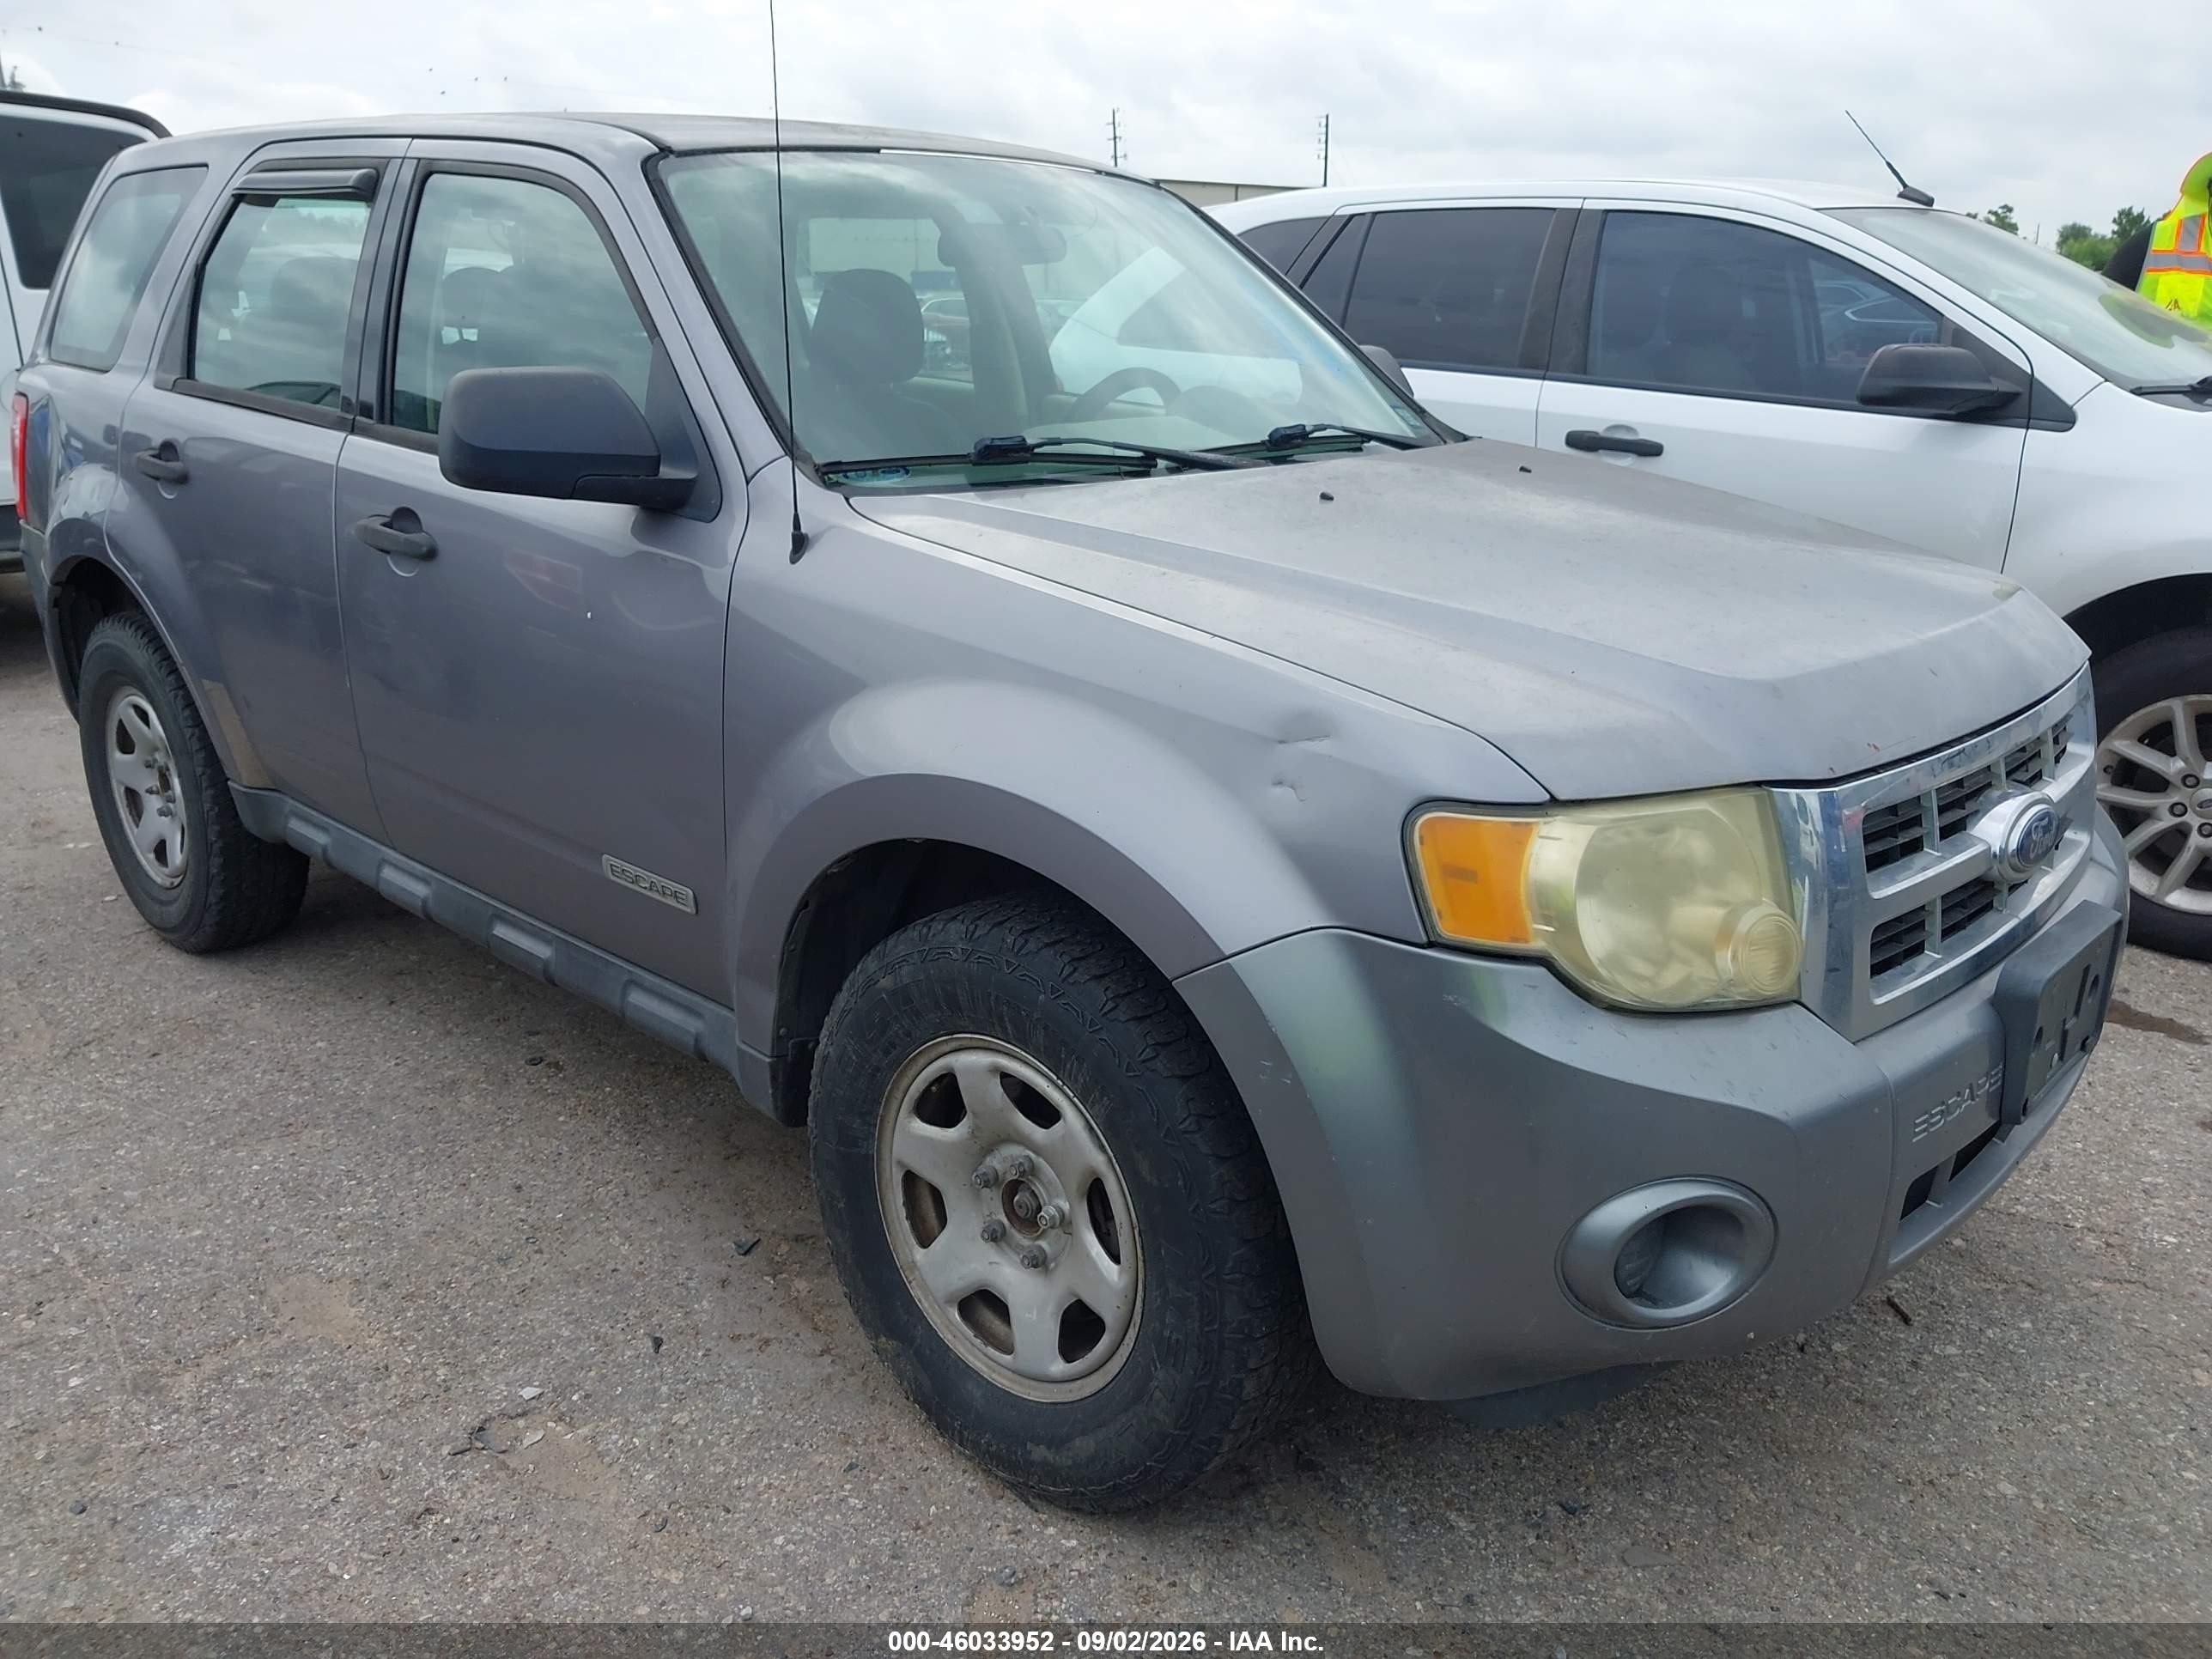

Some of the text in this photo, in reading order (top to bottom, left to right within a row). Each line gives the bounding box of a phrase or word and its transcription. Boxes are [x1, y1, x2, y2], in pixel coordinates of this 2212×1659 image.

[2029, 817, 2057, 860] Ford
[609, 862, 688, 907] ESCAPE
[1911, 1062, 2003, 1143] ESCAPE
